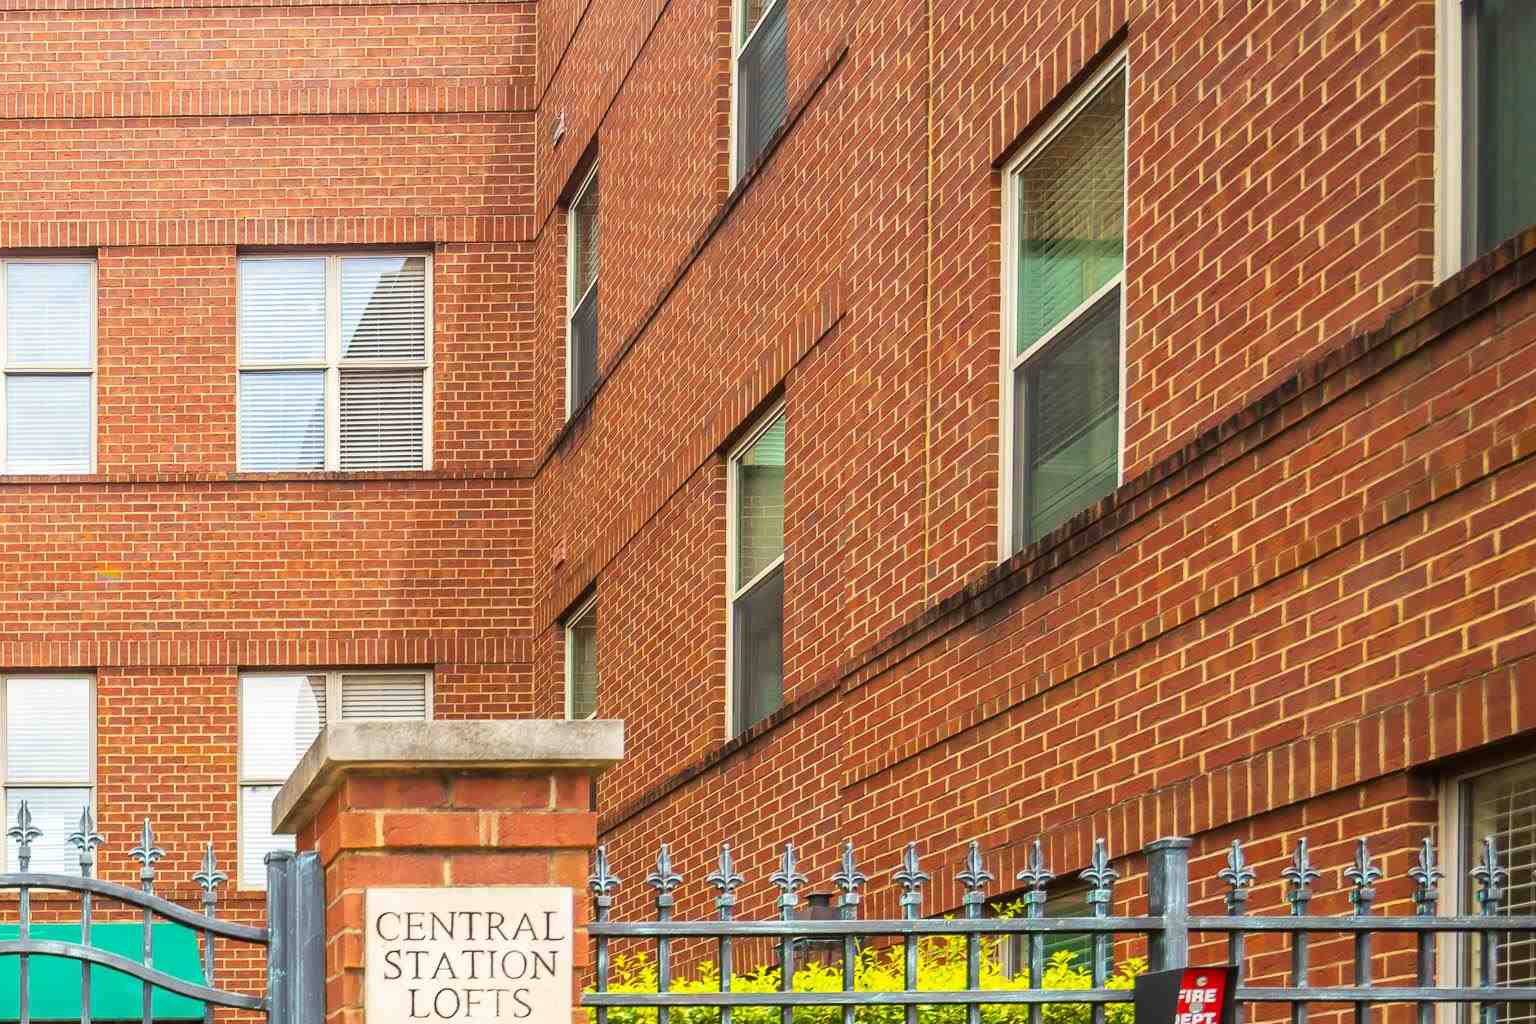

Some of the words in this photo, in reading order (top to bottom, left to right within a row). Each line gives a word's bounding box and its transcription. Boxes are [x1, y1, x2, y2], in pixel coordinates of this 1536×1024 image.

[375, 911, 565, 941] CENTRAL
[383, 949, 559, 980] STATION
[407, 987, 533, 1019] LOFTS
